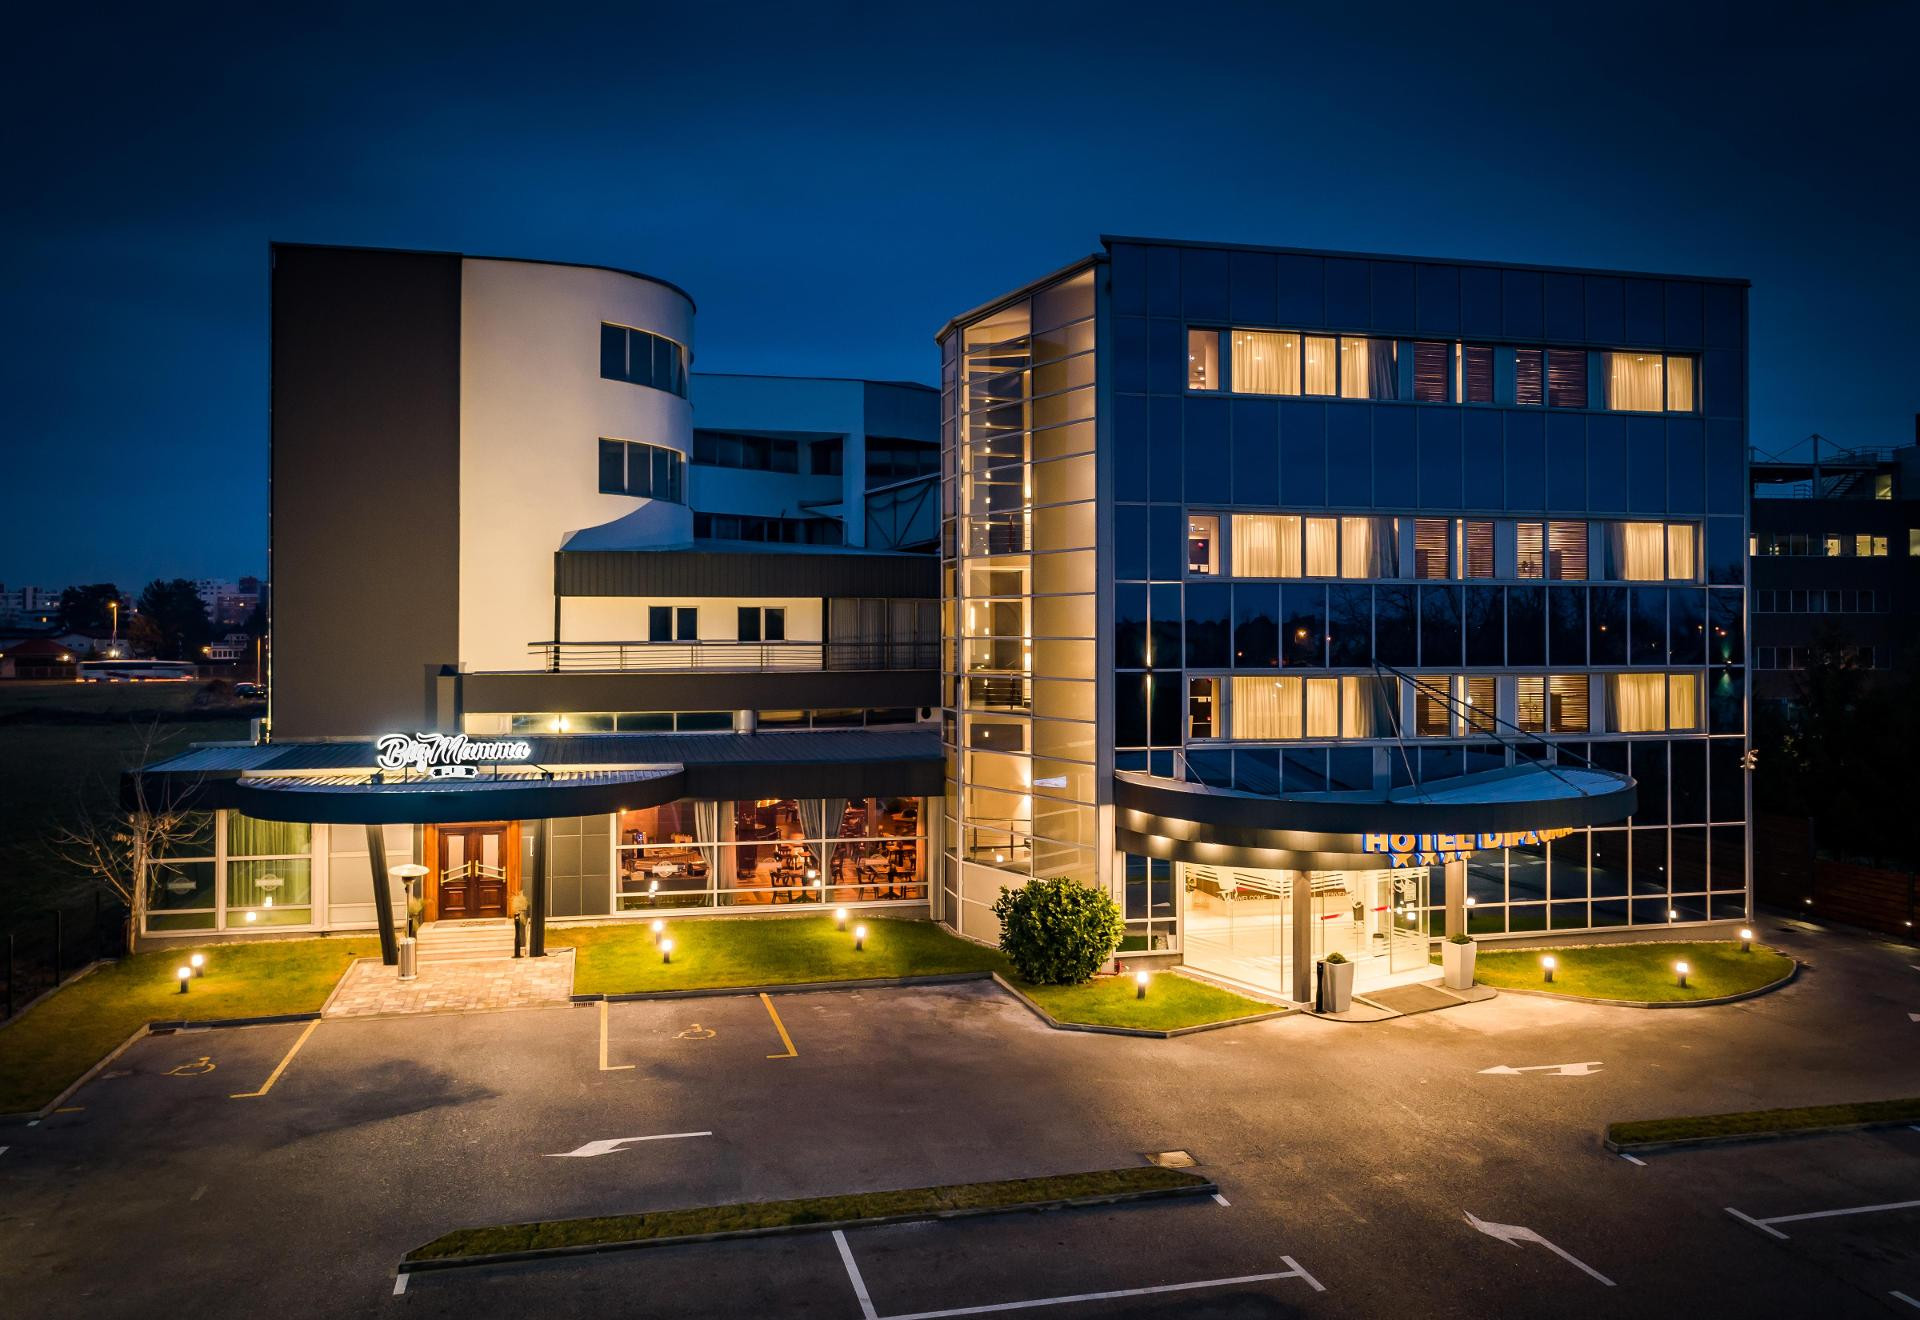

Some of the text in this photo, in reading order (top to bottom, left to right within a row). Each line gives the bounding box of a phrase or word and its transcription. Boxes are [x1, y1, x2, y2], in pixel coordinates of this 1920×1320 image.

[377, 732, 532, 773] Big Mamma
[1363, 833, 1474, 853] HOTEL
